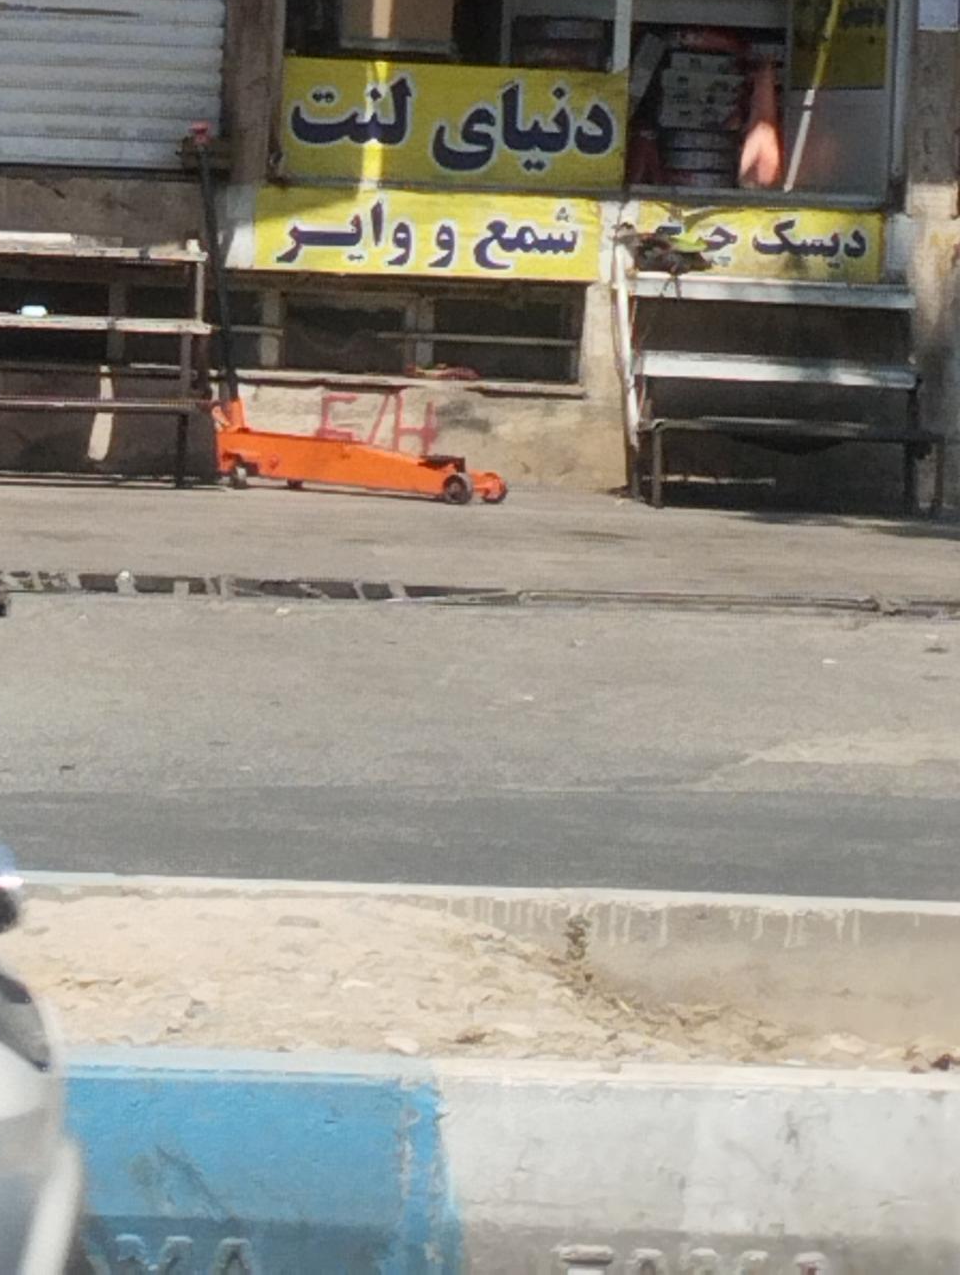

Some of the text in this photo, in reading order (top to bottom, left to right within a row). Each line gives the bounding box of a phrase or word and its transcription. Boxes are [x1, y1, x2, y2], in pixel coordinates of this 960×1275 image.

[291, 77, 413, 146] لنت
[431, 81, 614, 172] دنیای
[276, 197, 578, 270] شمع و وایر
[752, 219, 867, 269] دیسک
